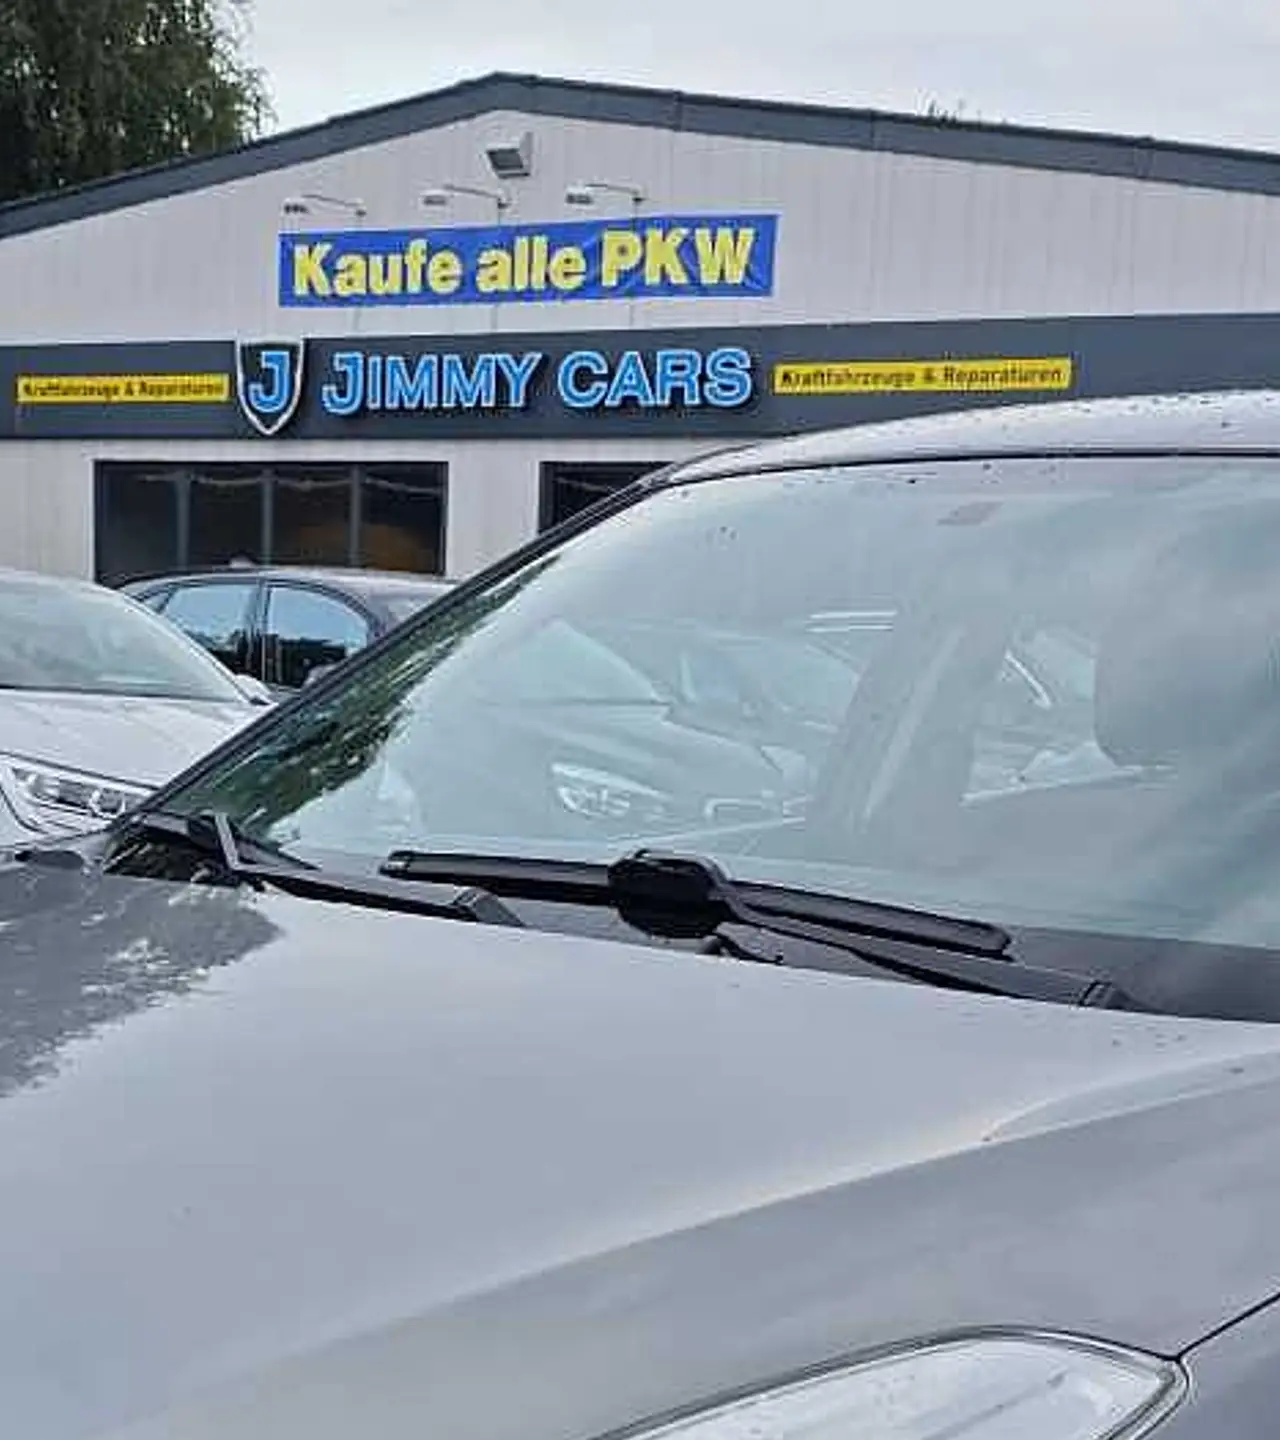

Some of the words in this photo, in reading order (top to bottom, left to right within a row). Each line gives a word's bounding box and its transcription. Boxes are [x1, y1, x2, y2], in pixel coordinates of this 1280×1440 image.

[292, 238, 464, 297] Kaufe
[476, 235, 587, 293] alle
[600, 226, 755, 287] PKW
[248, 350, 291, 413] J
[322, 350, 544, 415] JIMMY
[557, 347, 754, 408] CARS
